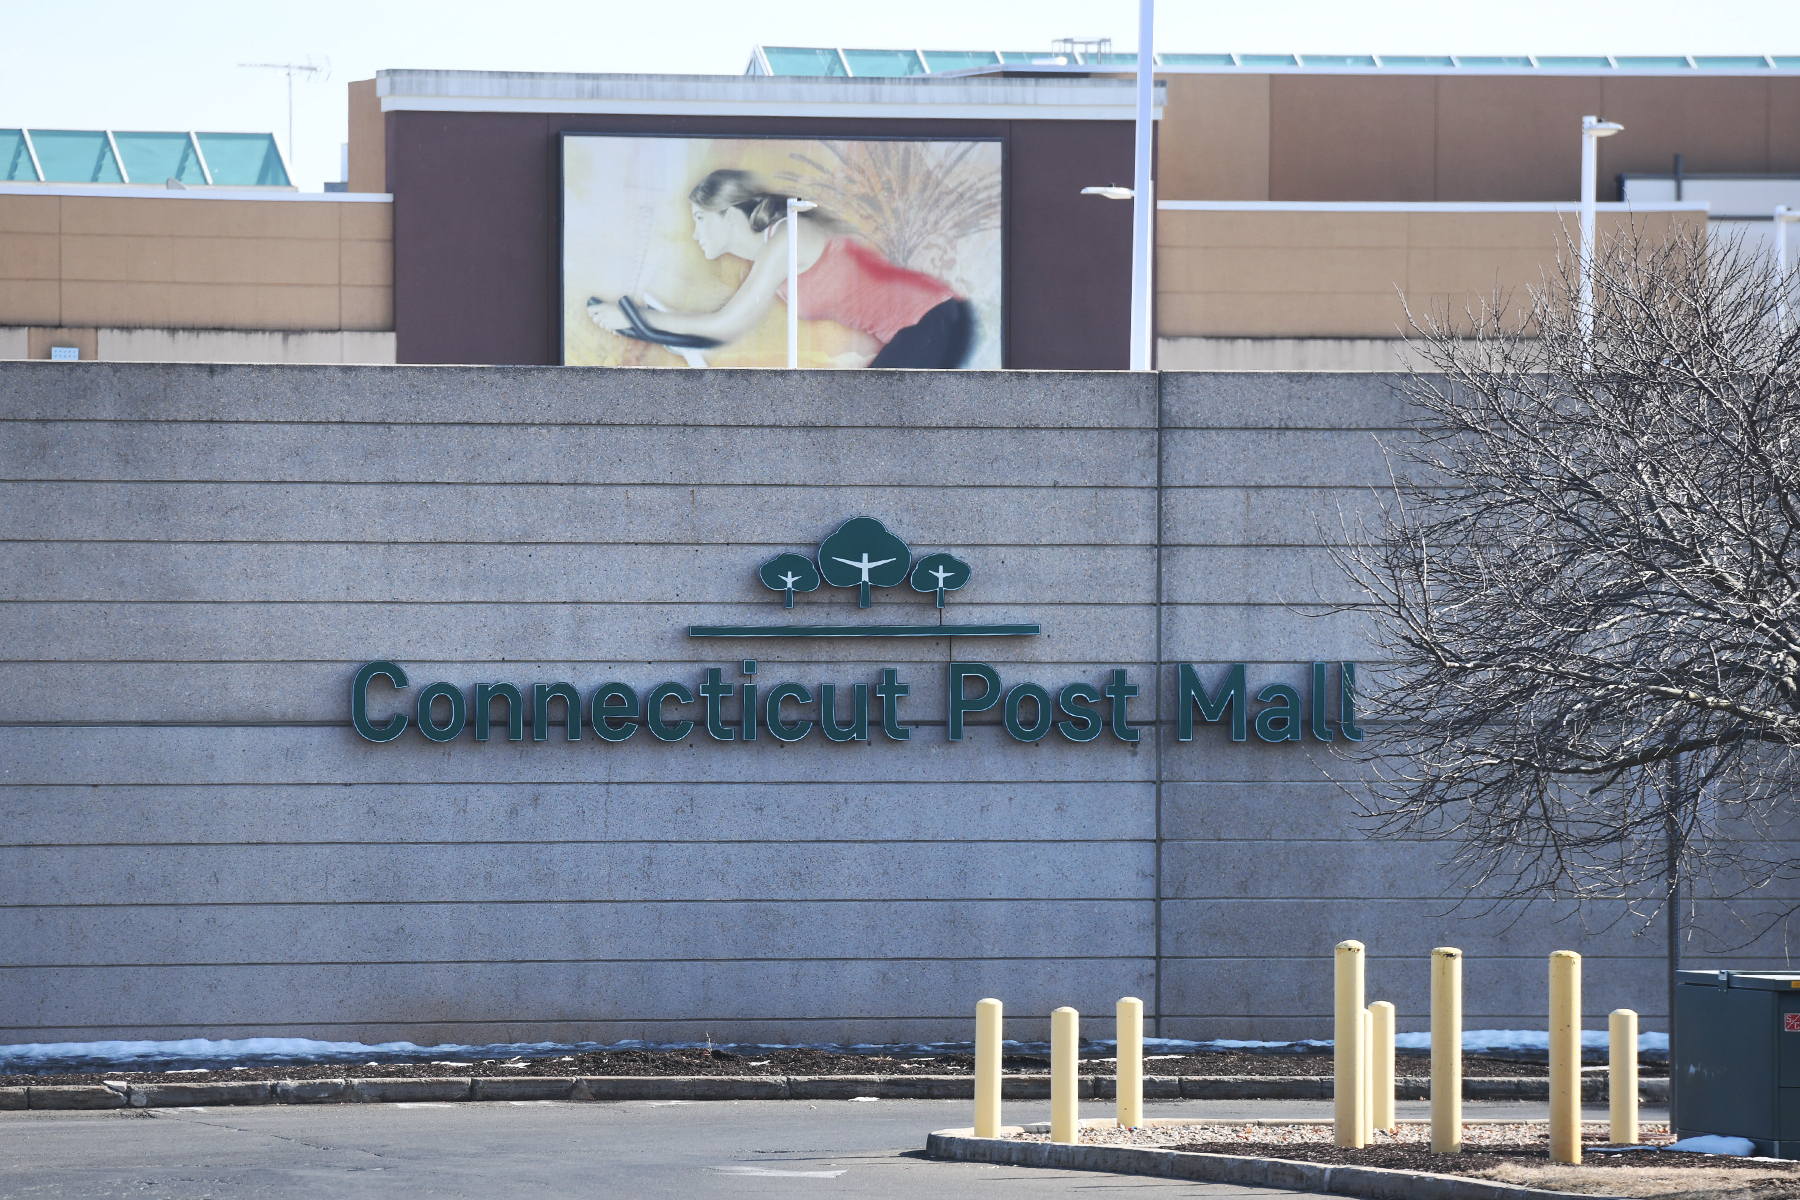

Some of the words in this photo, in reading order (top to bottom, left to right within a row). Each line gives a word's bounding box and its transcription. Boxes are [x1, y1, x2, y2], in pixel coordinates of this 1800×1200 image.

[351, 659, 910, 742] Connecticut
[949, 662, 1140, 742] Post
[1178, 661, 1363, 742] Mall
